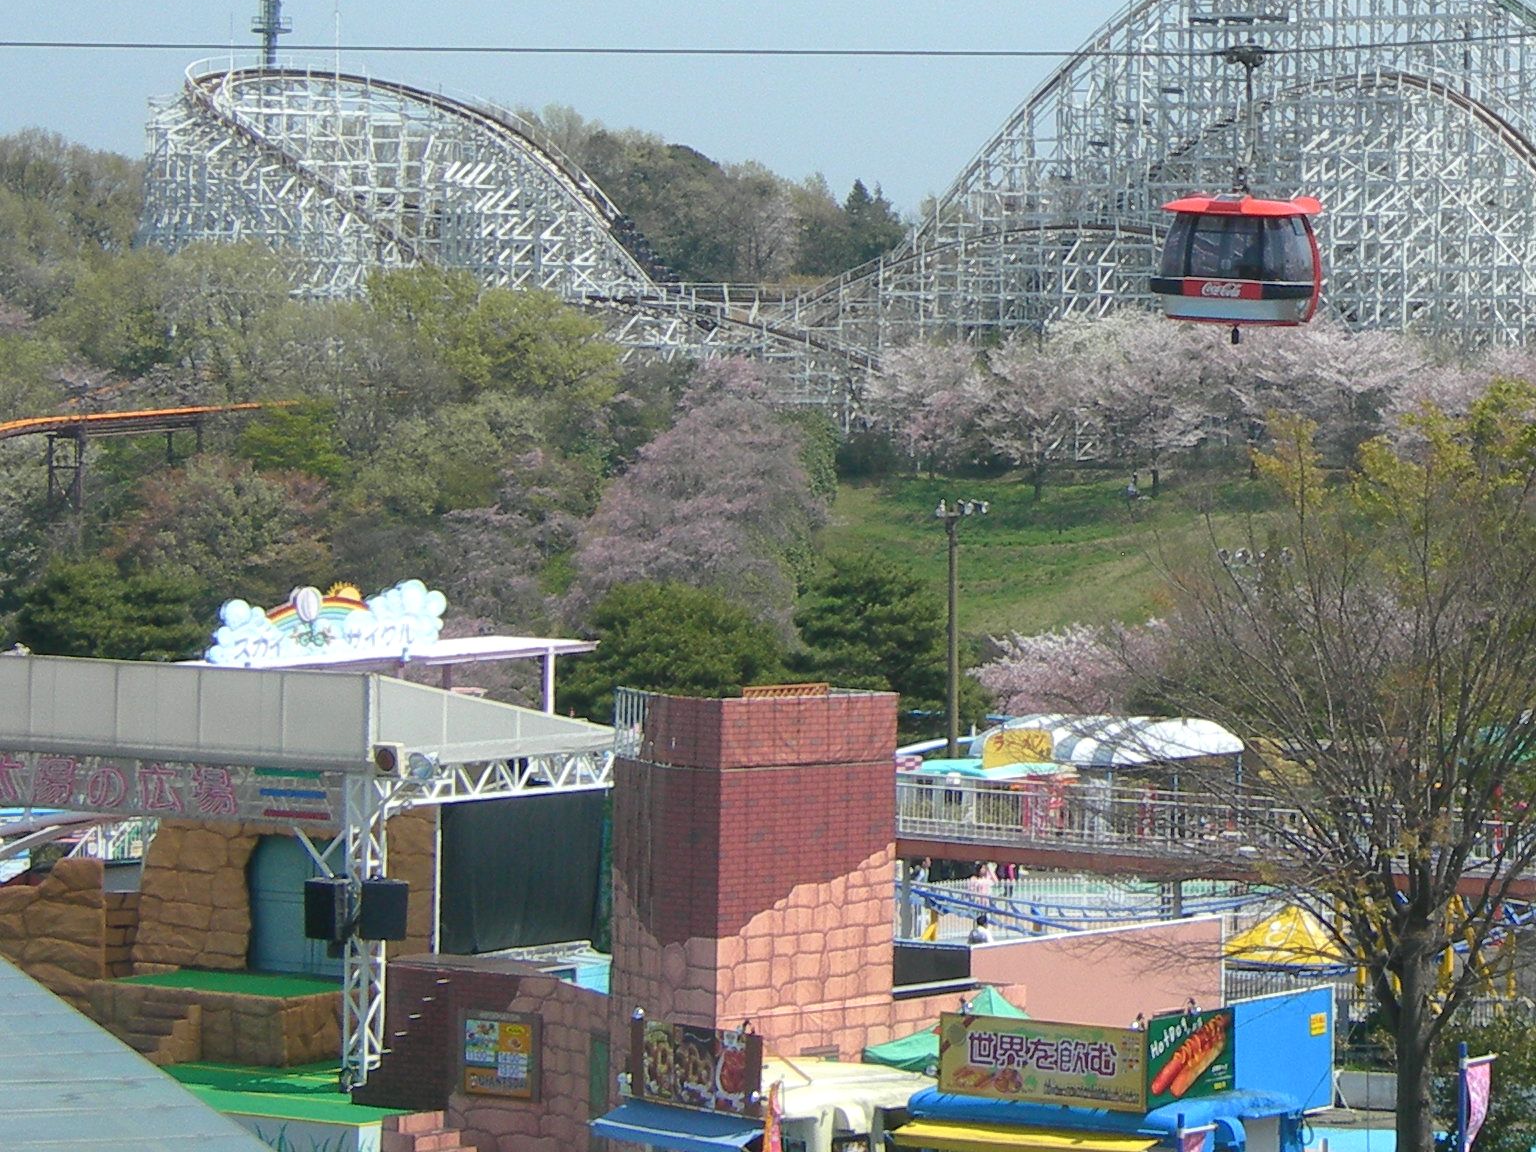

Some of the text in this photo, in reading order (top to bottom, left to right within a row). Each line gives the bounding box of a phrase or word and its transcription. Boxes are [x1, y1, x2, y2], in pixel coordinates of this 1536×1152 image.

[233, 622, 416, 660] スカイ サイクル
[968, 1030, 1119, 1078] 世界を飲む
